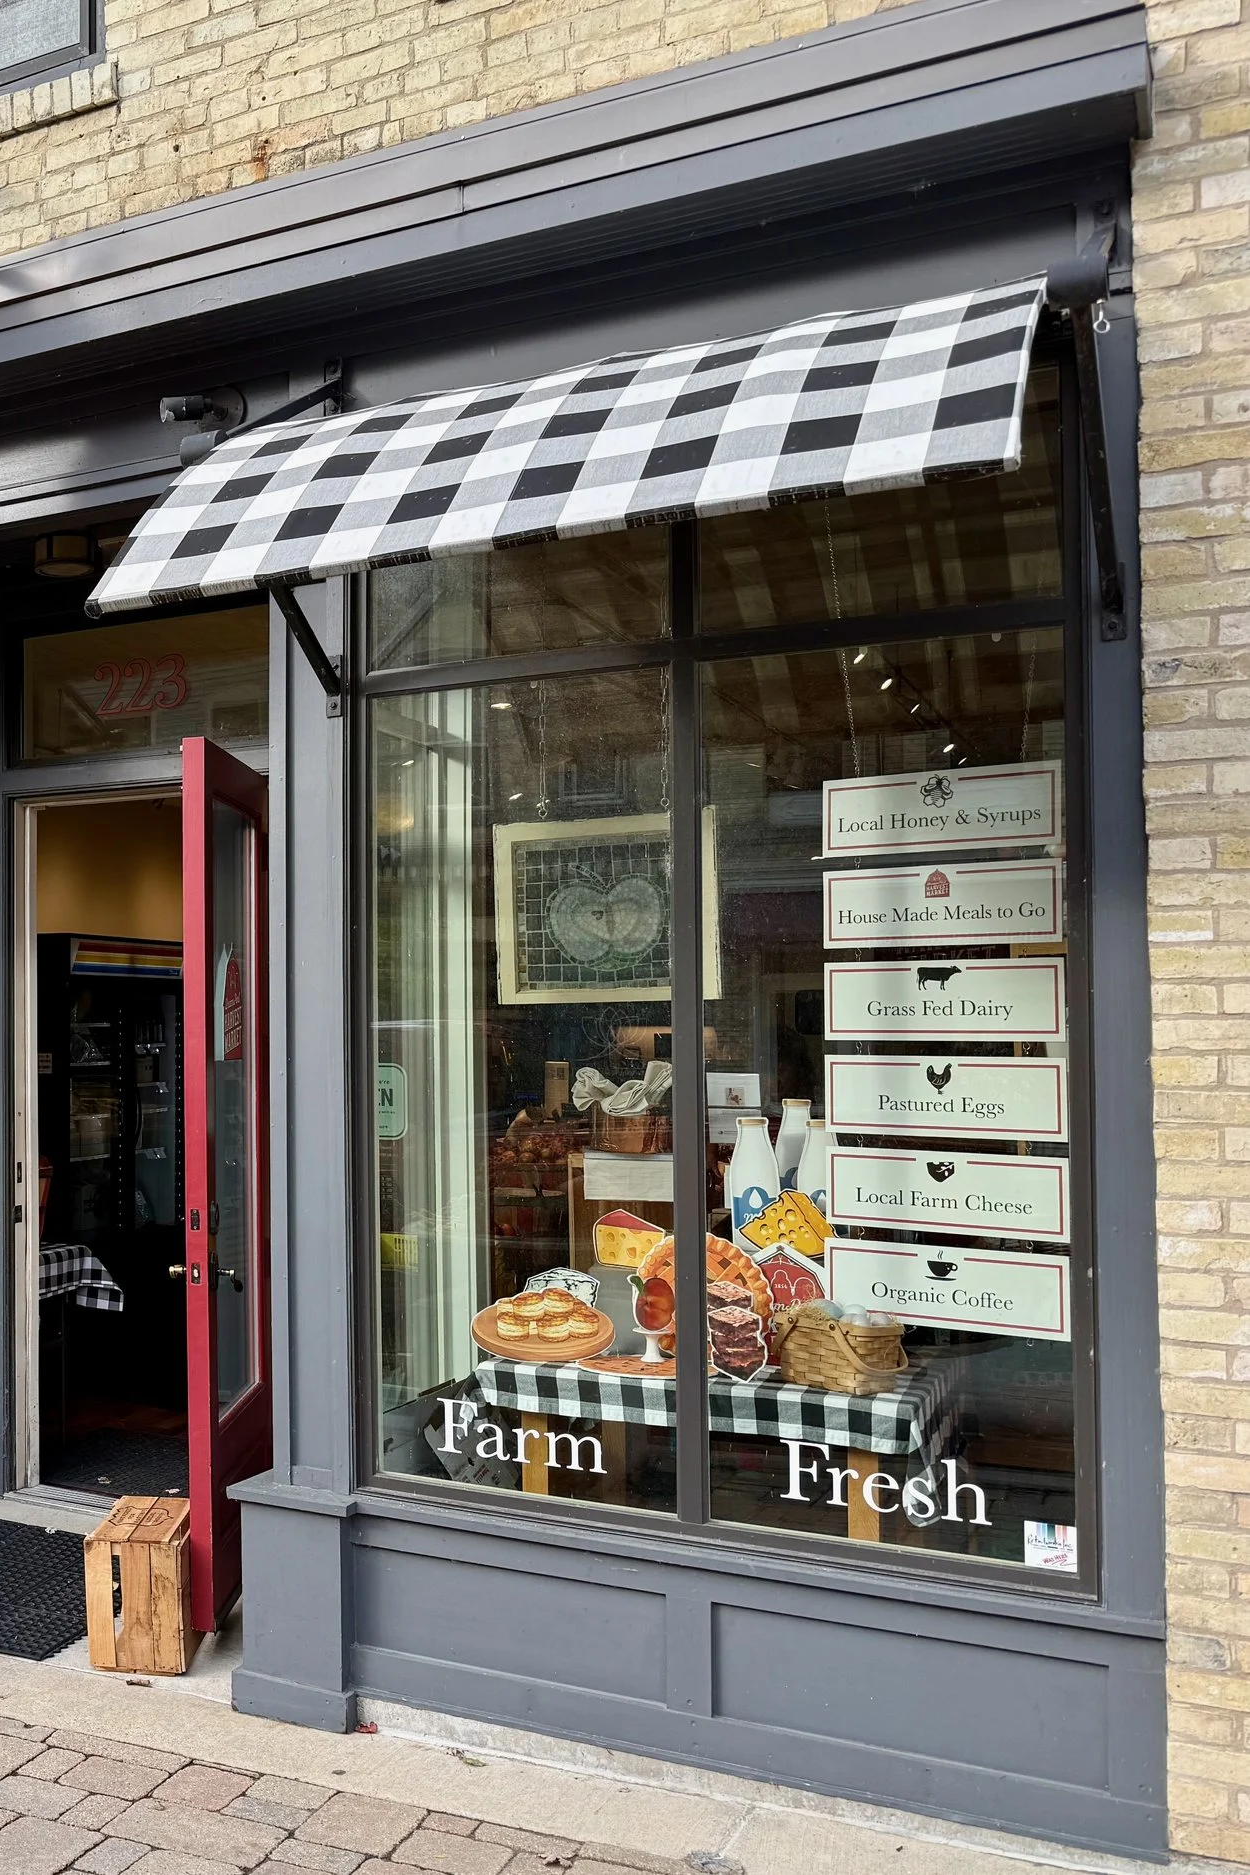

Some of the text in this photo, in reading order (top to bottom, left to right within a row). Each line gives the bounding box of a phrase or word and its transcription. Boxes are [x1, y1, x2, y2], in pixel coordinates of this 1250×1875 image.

[94, 653, 188, 716] 223
[837, 806, 1041, 833] Local Honey & Syrups
[838, 902, 1046, 925] House Made Meals to Go
[867, 1000, 1013, 1020] Grass Fed Dairy
[878, 1094, 1005, 1119] Pastured Eggs
[855, 1187, 1033, 1215] Local Farm Cheese
[871, 1281, 1014, 1311] Organic Coffee
[437, 1397, 608, 1474] Farm
[779, 1439, 993, 1526] Fresh
